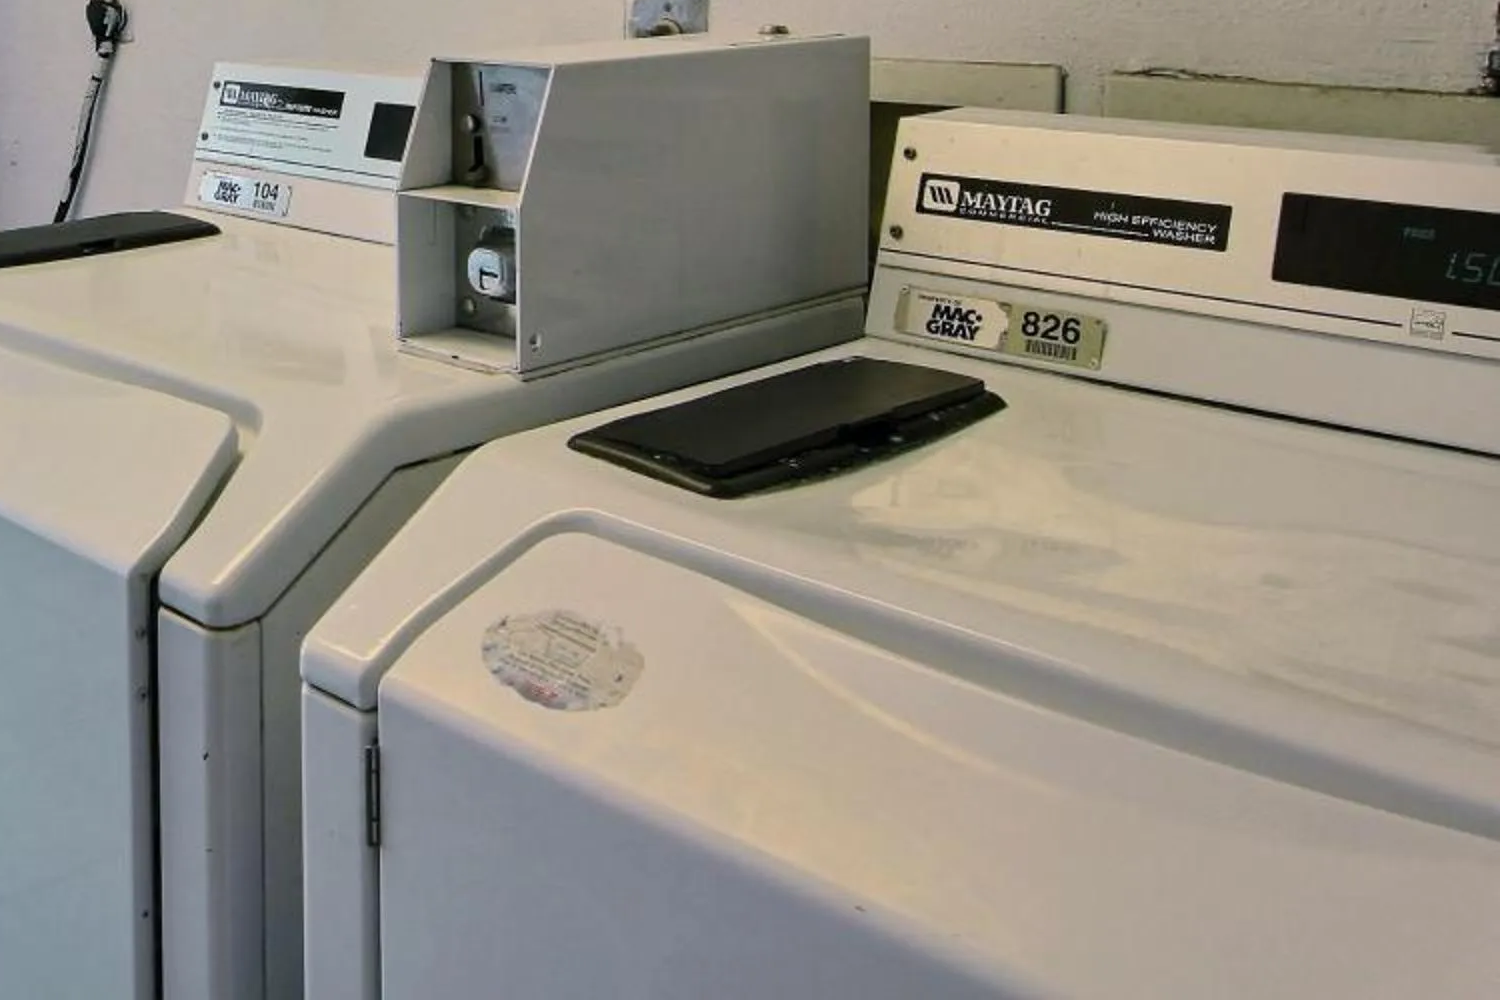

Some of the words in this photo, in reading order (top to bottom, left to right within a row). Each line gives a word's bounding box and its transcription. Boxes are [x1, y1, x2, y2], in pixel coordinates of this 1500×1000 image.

[253, 181, 279, 200] 104
[960, 191, 1051, 217] MAYTAG
[1093, 211, 1129, 225] HIGH
[1131, 214, 1217, 234] EFFICIENCY
[1153, 228, 1216, 244] WASHER
[926, 320, 980, 341] GRAY
[1021, 311, 1080, 344] 826
